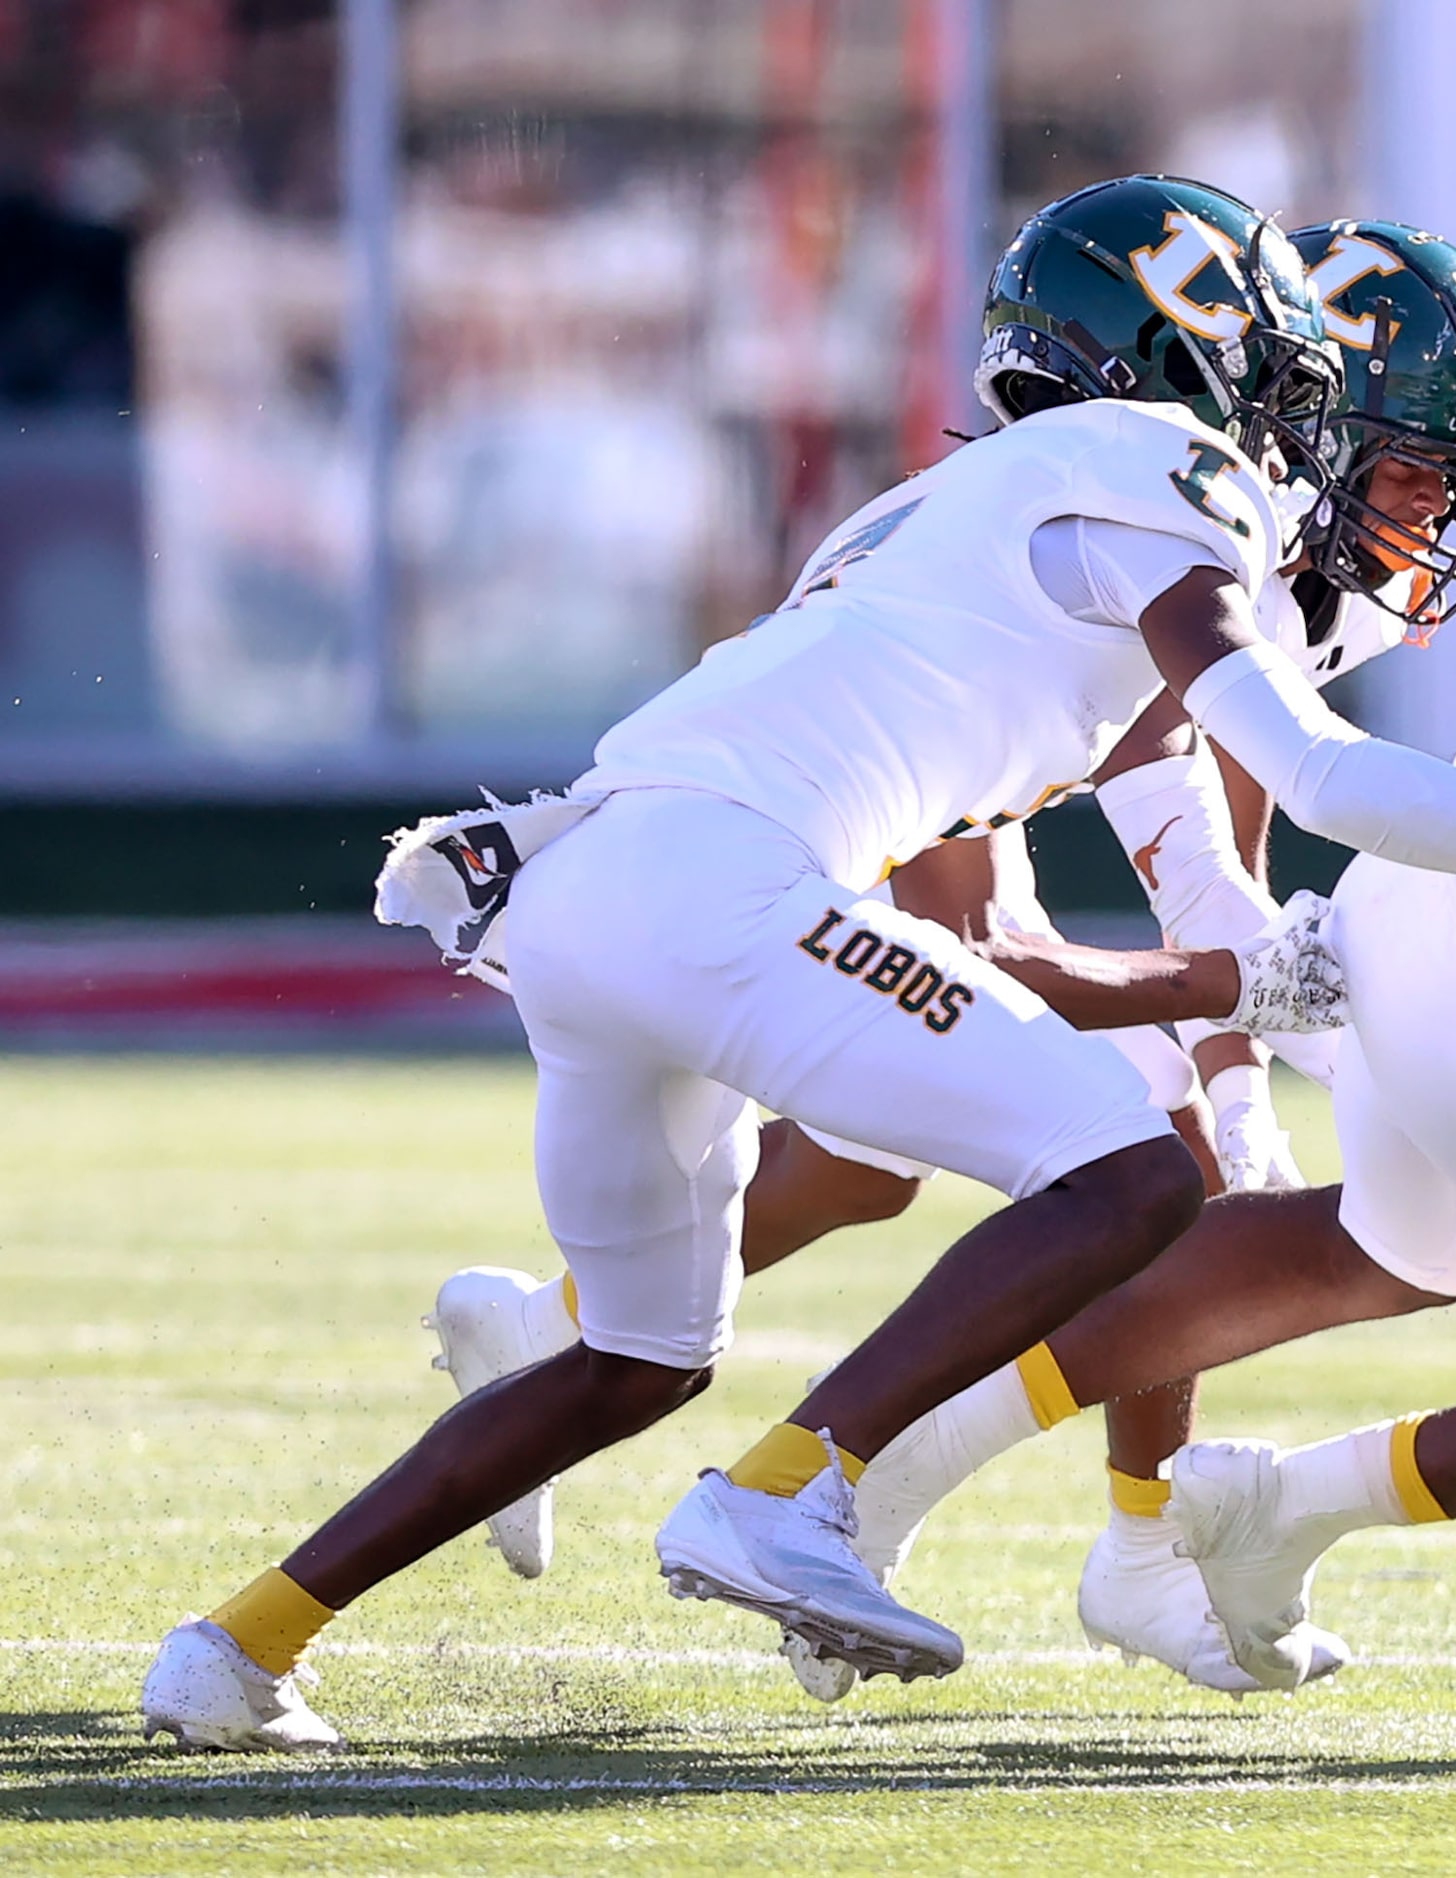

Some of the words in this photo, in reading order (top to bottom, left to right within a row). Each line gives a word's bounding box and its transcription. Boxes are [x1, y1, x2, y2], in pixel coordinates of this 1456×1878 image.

[1129, 211, 1253, 340] L
[1306, 234, 1406, 351] L
[1168, 438, 1250, 540] L
[796, 907, 976, 1036] LOBOS
